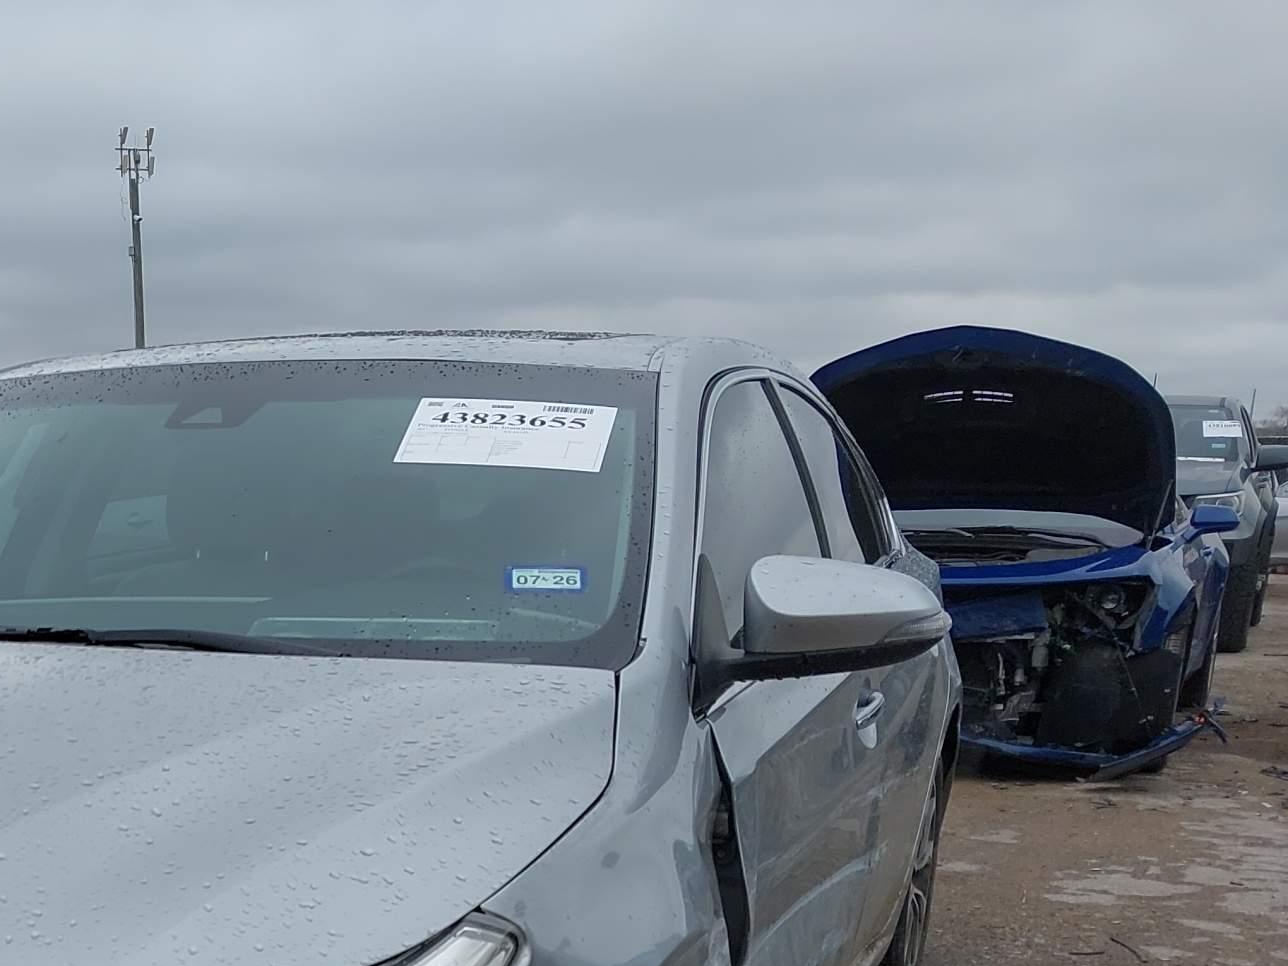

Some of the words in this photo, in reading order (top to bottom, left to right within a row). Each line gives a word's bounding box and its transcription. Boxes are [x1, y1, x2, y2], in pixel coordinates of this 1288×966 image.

[431, 411, 588, 429] 43823655
[516, 575, 540, 585] 07
[552, 575, 578, 586] 26
